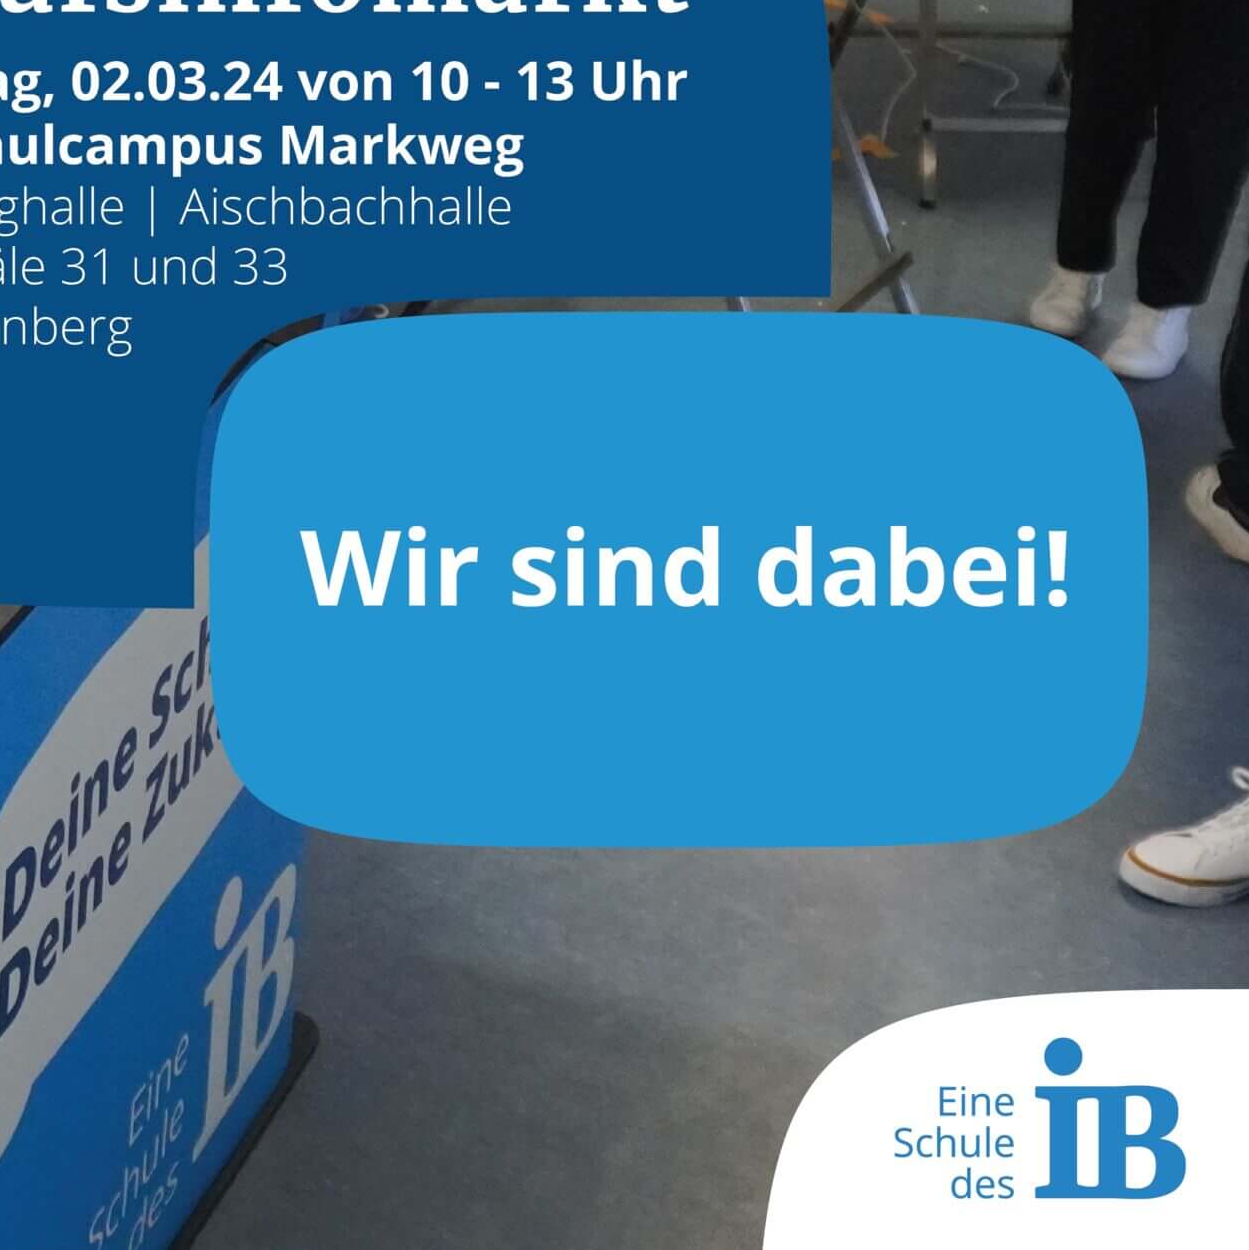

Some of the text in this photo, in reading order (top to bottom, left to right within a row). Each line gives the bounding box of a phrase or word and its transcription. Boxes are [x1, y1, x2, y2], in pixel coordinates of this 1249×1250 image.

[1, 726, 138, 942] Deine
[143, 701, 221, 845] Zuk
[129, 1031, 190, 1148] Eine
